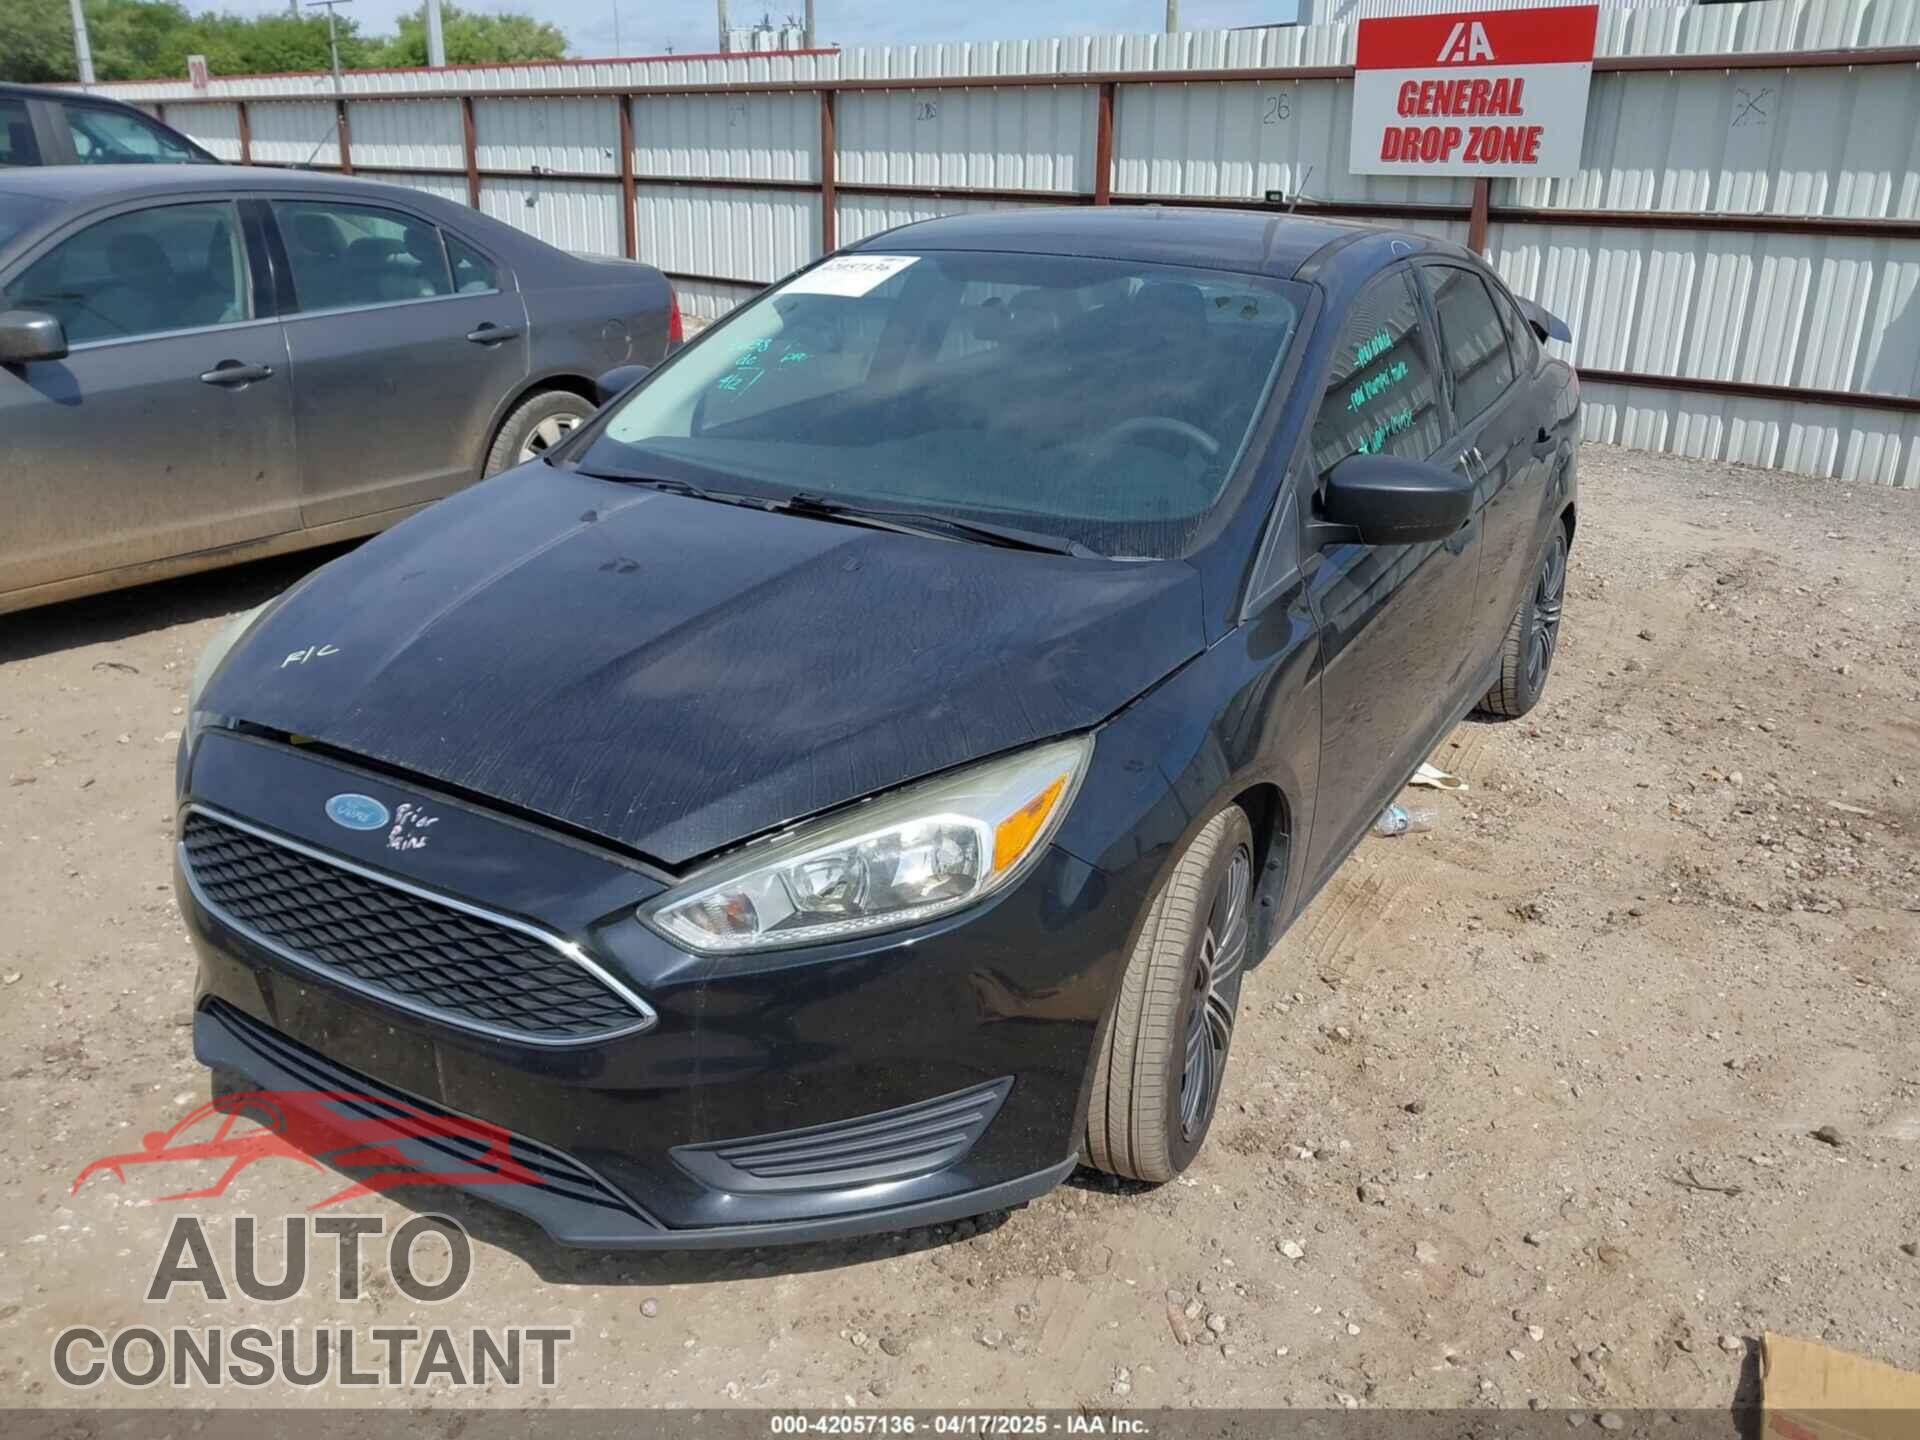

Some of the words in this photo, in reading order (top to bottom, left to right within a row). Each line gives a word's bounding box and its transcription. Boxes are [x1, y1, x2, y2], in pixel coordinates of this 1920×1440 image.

[1262, 93, 1291, 125] 26
[1396, 77, 1526, 118] GENERAL
[1379, 125, 1463, 163] DROP
[1462, 125, 1545, 164] ZONE
